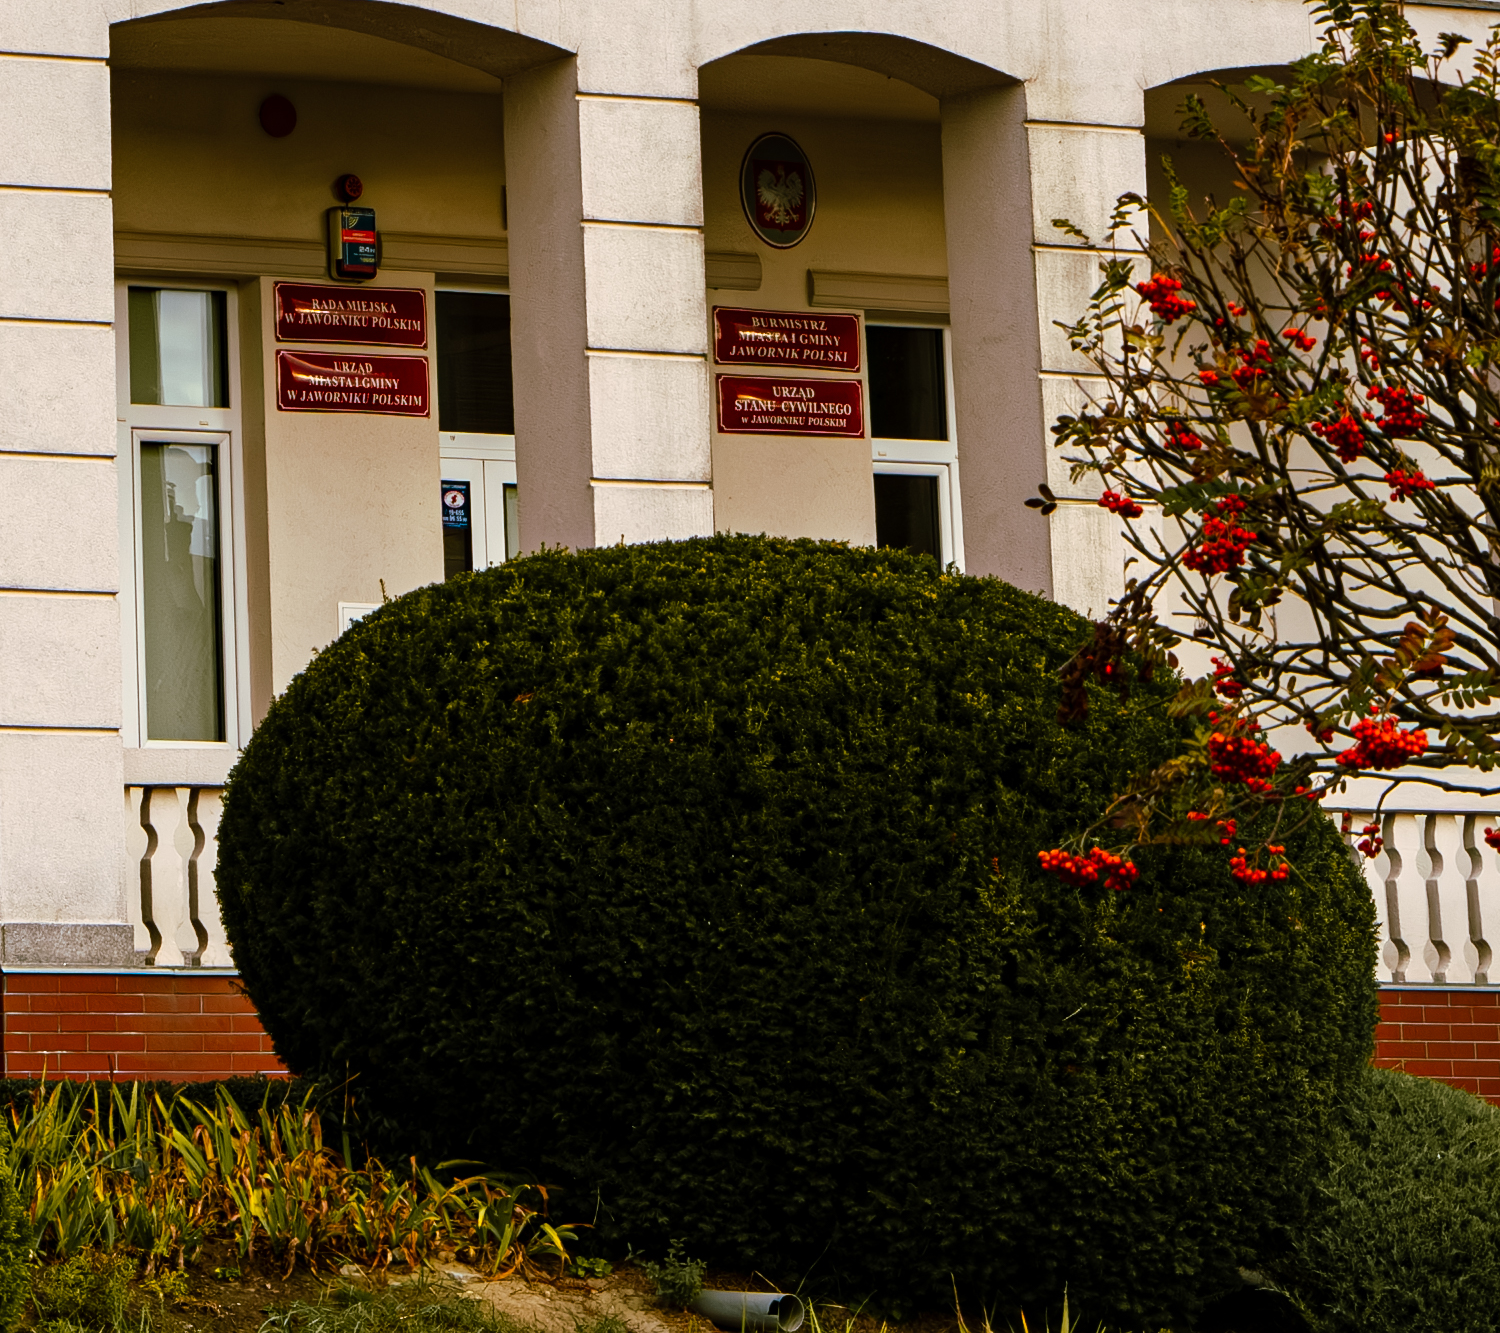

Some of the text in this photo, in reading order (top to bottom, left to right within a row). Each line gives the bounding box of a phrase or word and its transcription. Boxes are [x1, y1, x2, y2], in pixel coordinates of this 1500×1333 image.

[312, 299, 397, 314] RADA MIEJSKA
[285, 313, 421, 331] W JAWORNIKU POLSKIM
[752, 317, 828, 331] BURMISTRZ
[739, 331, 841, 346] MIASTA I GMINY
[730, 346, 848, 362] JAWORNIK POLSKI
[334, 361, 373, 375] URZĄD
[309, 375, 355, 388] MIASTA
[362, 378, 400, 390] GMINY
[287, 390, 422, 407] W JAWORNIKU POLSKIM
[772, 386, 815, 401] URZĄD
[735, 399, 852, 415] STANU CYWILNEGO
[751, 415, 805, 425] JAWORNIKU
[808, 417, 847, 427] POLSKIM
